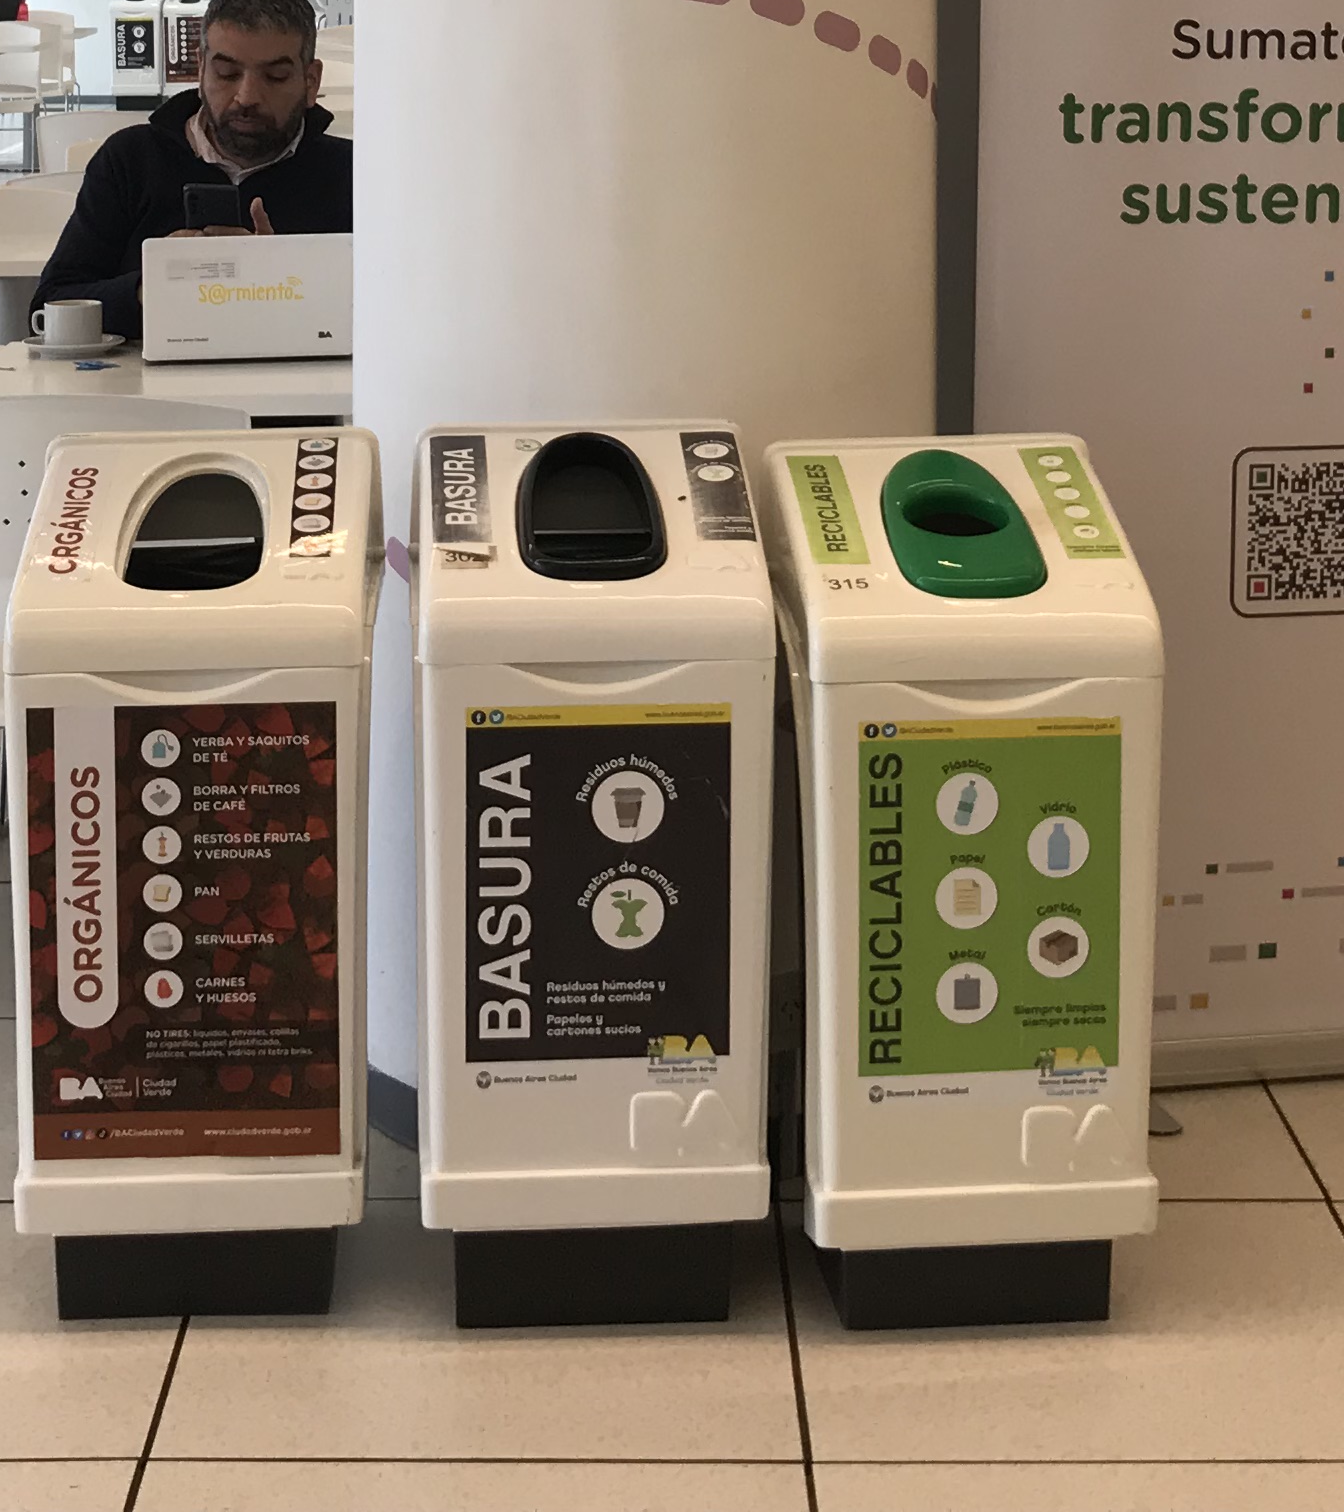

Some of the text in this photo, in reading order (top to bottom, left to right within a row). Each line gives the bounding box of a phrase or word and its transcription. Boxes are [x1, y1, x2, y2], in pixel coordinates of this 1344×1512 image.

[117, 24, 127, 67] BASURA
[442, 447, 479, 526] BASURA
[804, 463, 849, 553] RECICLABLES
[48, 466, 99, 575] ORGÁNICOS
[828, 577, 869, 590] 315
[192, 735, 310, 747] YERBA Y SAQUITOS
[193, 750, 228, 763] DE TÉ
[575, 753, 678, 803] Residuos húmedos
[193, 784, 301, 796] BORRA Y FILTROS
[193, 798, 246, 811] DE CAFÉ
[193, 832, 311, 844] RESTOS DE FRUTAS
[193, 848, 272, 859] Y VERDURAS
[950, 853, 986, 866] Papel
[63, 765, 103, 1003] ORGÁNICOS
[577, 861, 679, 908] Restos de comida
[194, 886, 220, 897] PAN
[477, 753, 532, 1039] BASURA
[868, 752, 903, 1065] RECICLABLES
[1036, 902, 1082, 917] Cartón
[194, 933, 275, 945] SERVILLETAS
[195, 977, 246, 988] CARNES
[546, 979, 666, 992] Residuos húmedos y
[196, 992, 257, 1003] Y HUESOS
[546, 991, 652, 1004] restos de comida
[546, 1013, 604, 1026] Papeles y
[145, 1030, 161, 1038] NO
[546, 1024, 642, 1036] cartones sucios
[59, 1076, 104, 1101] BA
[142, 1078, 177, 1087] Ciudad
[142, 1088, 172, 1096] Verde
